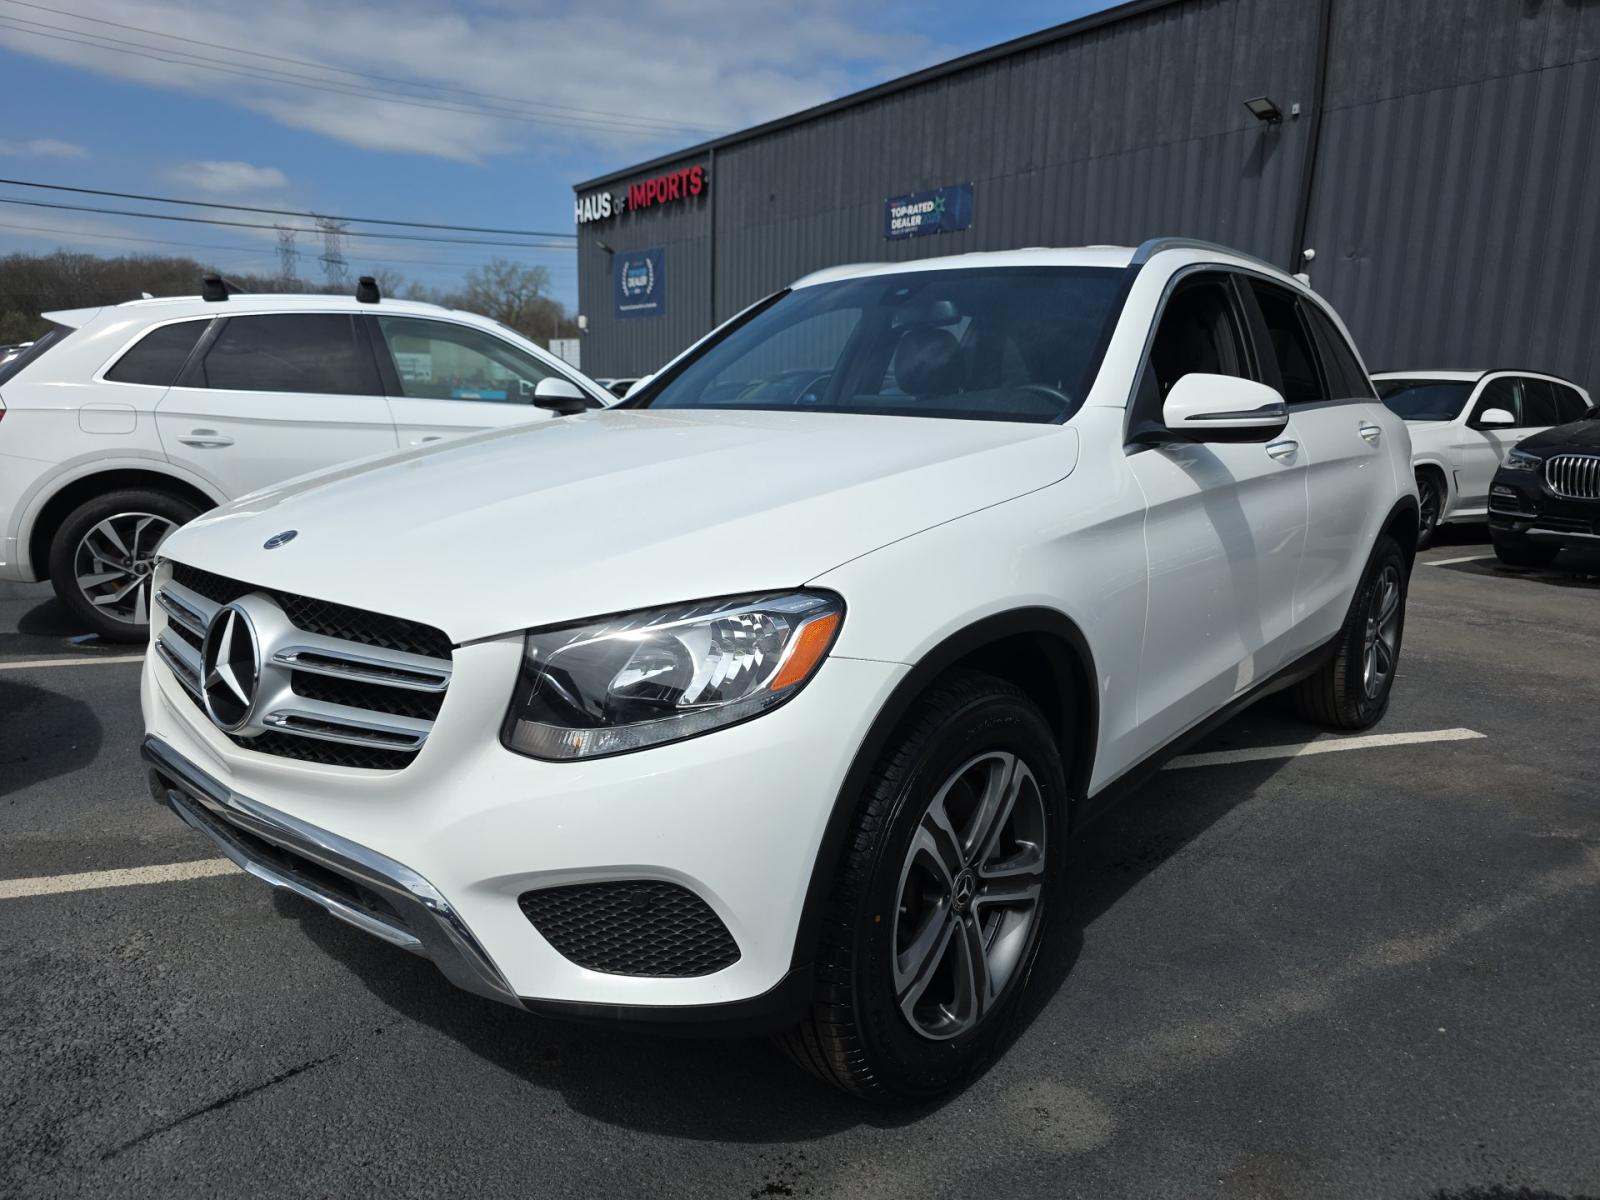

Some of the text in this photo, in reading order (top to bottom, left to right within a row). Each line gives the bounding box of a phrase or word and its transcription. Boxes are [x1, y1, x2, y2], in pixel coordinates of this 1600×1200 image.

[574, 165, 703, 224] HAUS OF IMPORTS
[891, 215, 922, 229] DEALER
